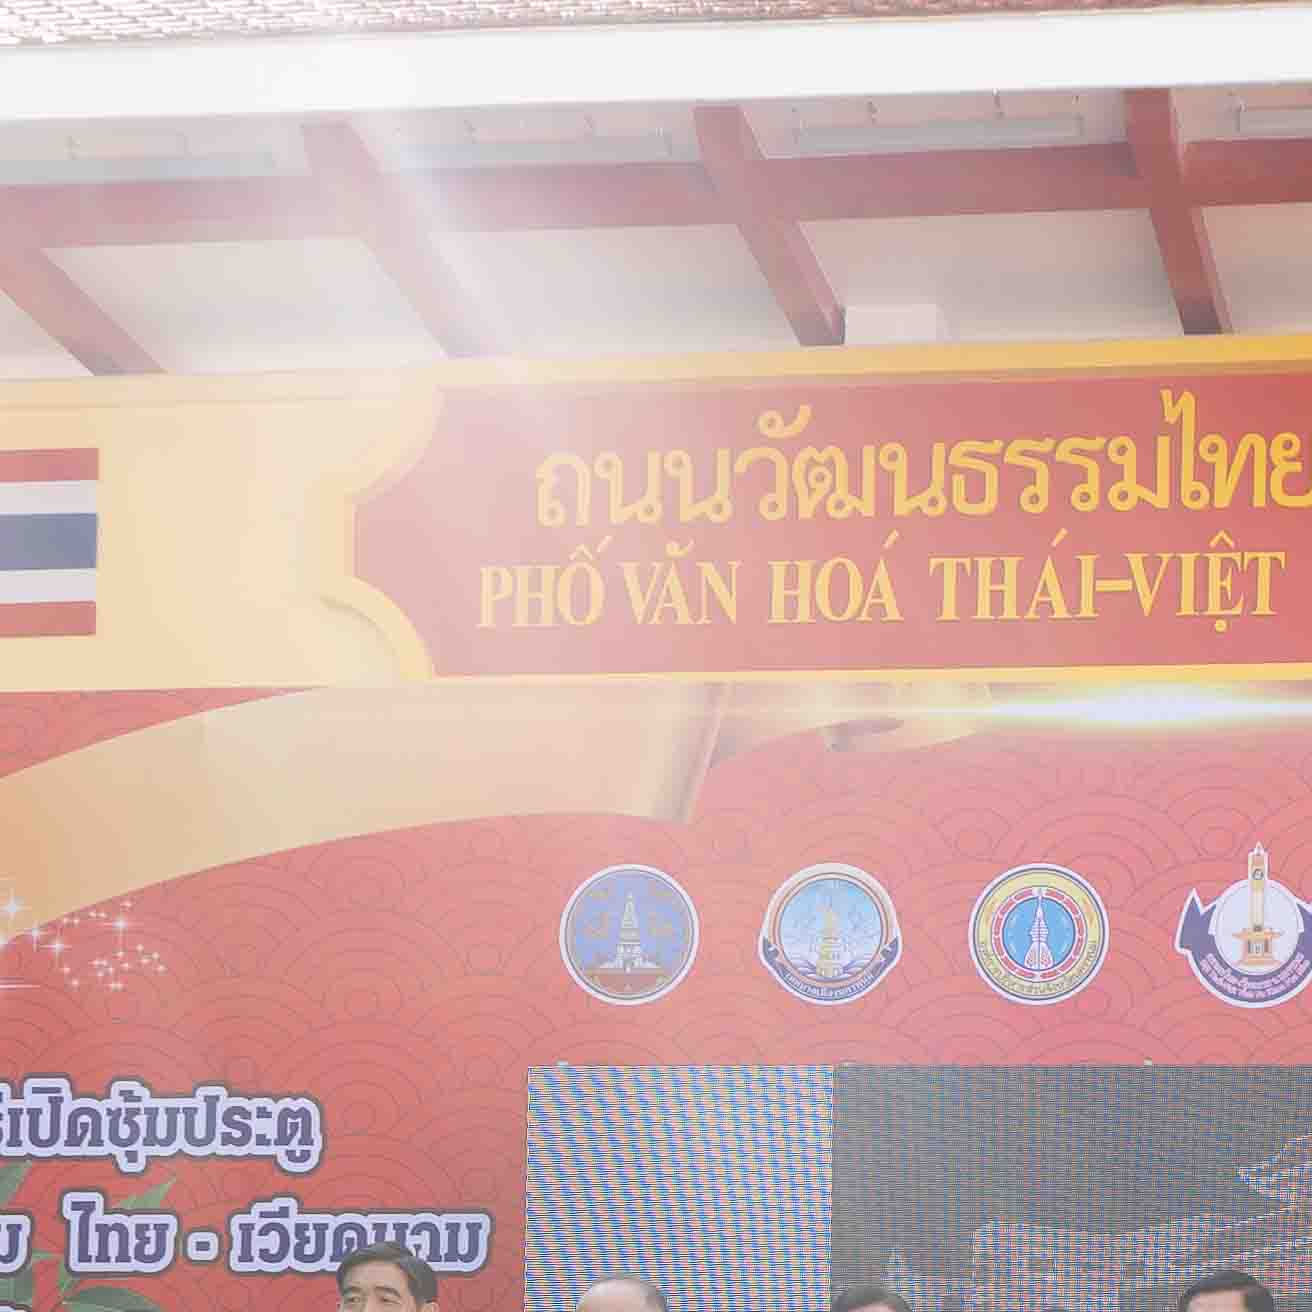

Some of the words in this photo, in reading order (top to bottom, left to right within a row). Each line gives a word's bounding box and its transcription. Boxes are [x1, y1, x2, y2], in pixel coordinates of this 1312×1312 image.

[478, 535, 612, 630] PHỐ
[623, 540, 740, 628] VĂN
[768, 529, 904, 625] HOÁ
[66, 1198, 170, 1266] ไทย
